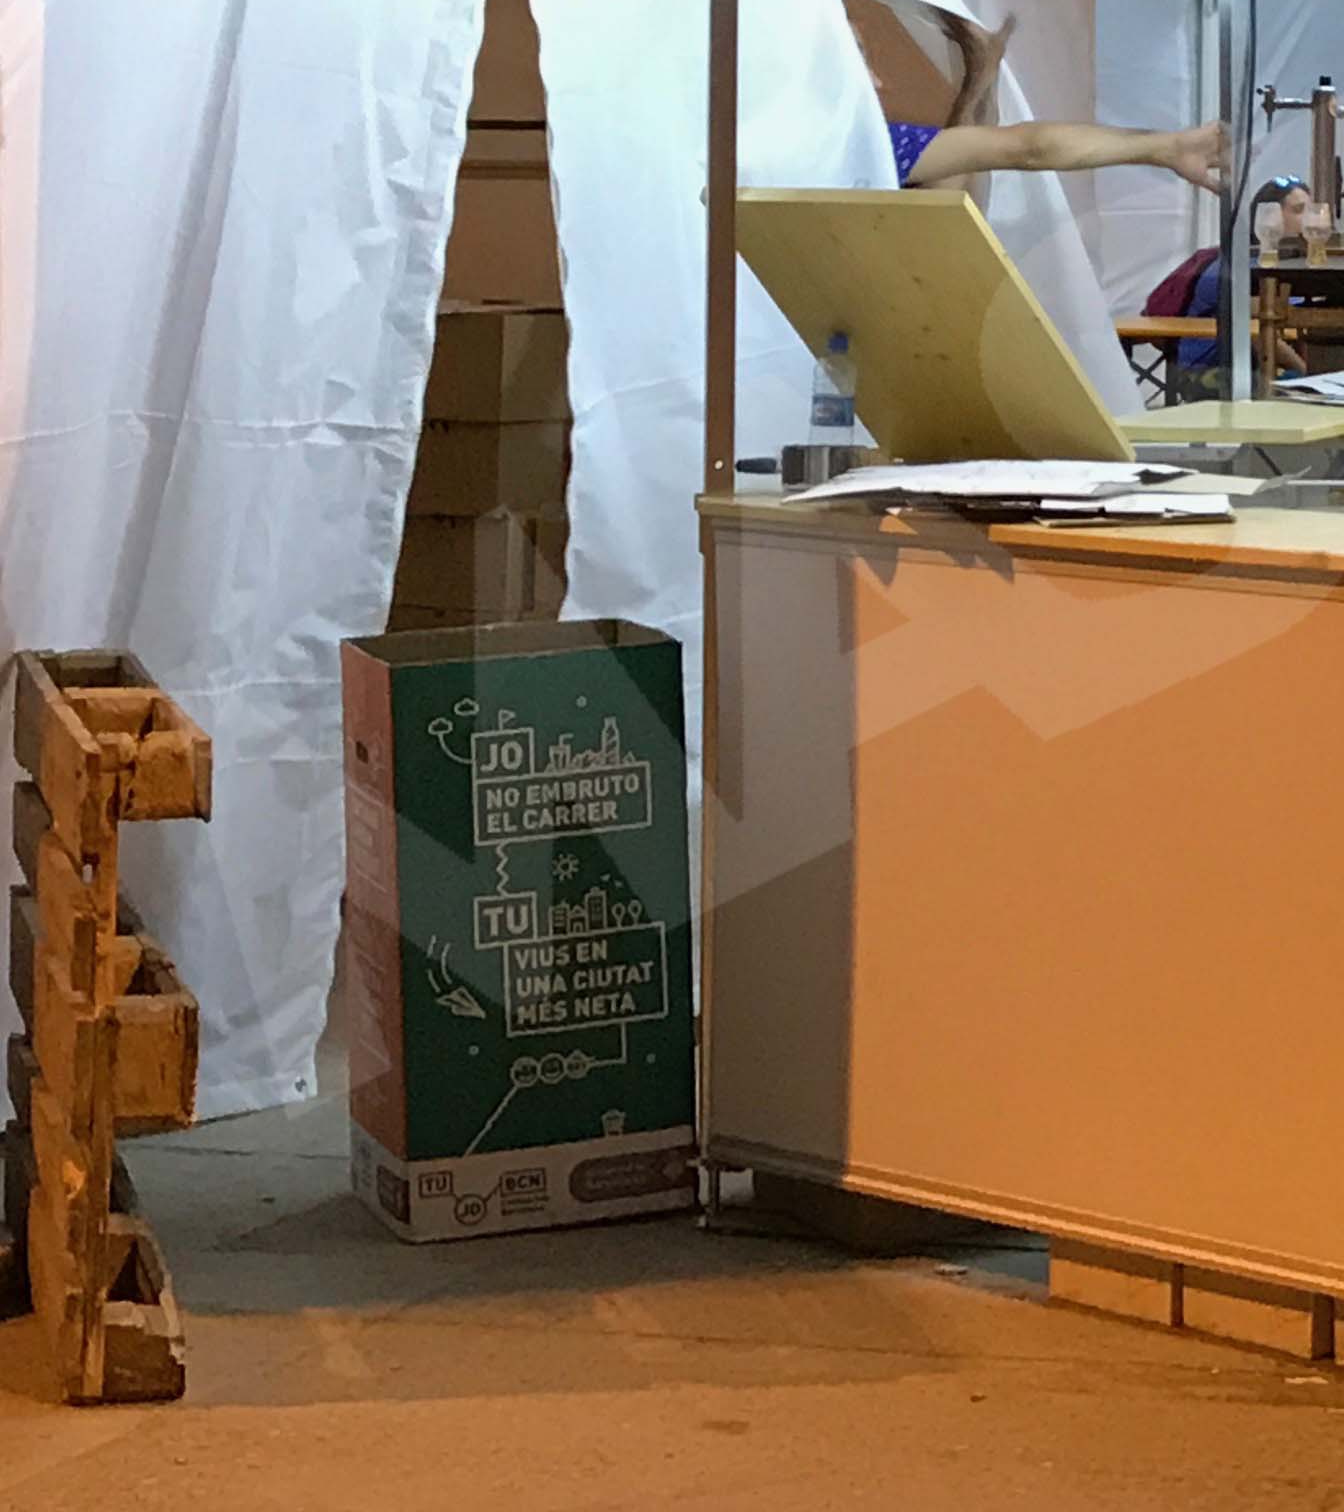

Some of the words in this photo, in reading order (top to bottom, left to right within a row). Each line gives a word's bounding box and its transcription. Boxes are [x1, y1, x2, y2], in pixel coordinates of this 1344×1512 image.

[479, 741, 524, 772] JO
[486, 787, 521, 811] NO
[525, 772, 641, 806] EMBRUTO
[486, 811, 518, 834] EL
[522, 800, 618, 830] CARRER
[482, 904, 528, 937] TU
[514, 943, 571, 971] VIUS
[575, 939, 608, 963] EN
[516, 974, 568, 998] UNA
[572, 959, 655, 990] CIUTAT
[516, 995, 568, 1025] MÉS
[574, 992, 636, 1018] NETA
[425, 1176, 447, 1192] TU
